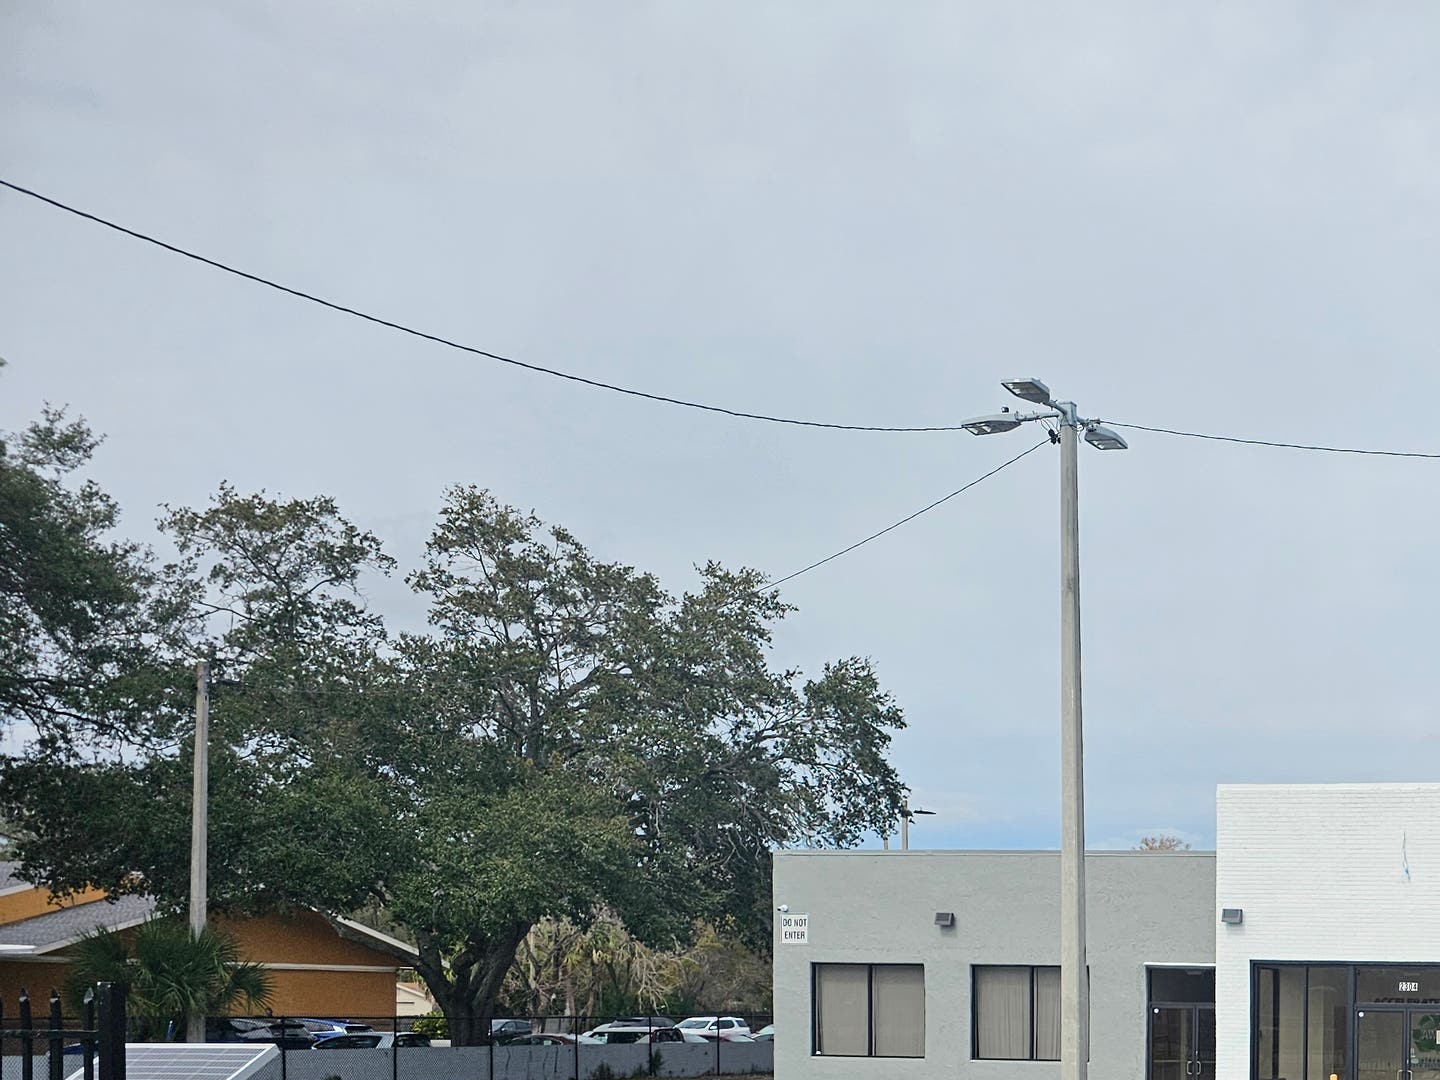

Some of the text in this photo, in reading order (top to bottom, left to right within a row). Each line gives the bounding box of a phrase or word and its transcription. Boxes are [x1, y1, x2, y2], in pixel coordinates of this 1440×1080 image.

[783, 919, 807, 927] DO NOT
[784, 931, 805, 939] ENTER
[1399, 982, 1418, 991] 2304
